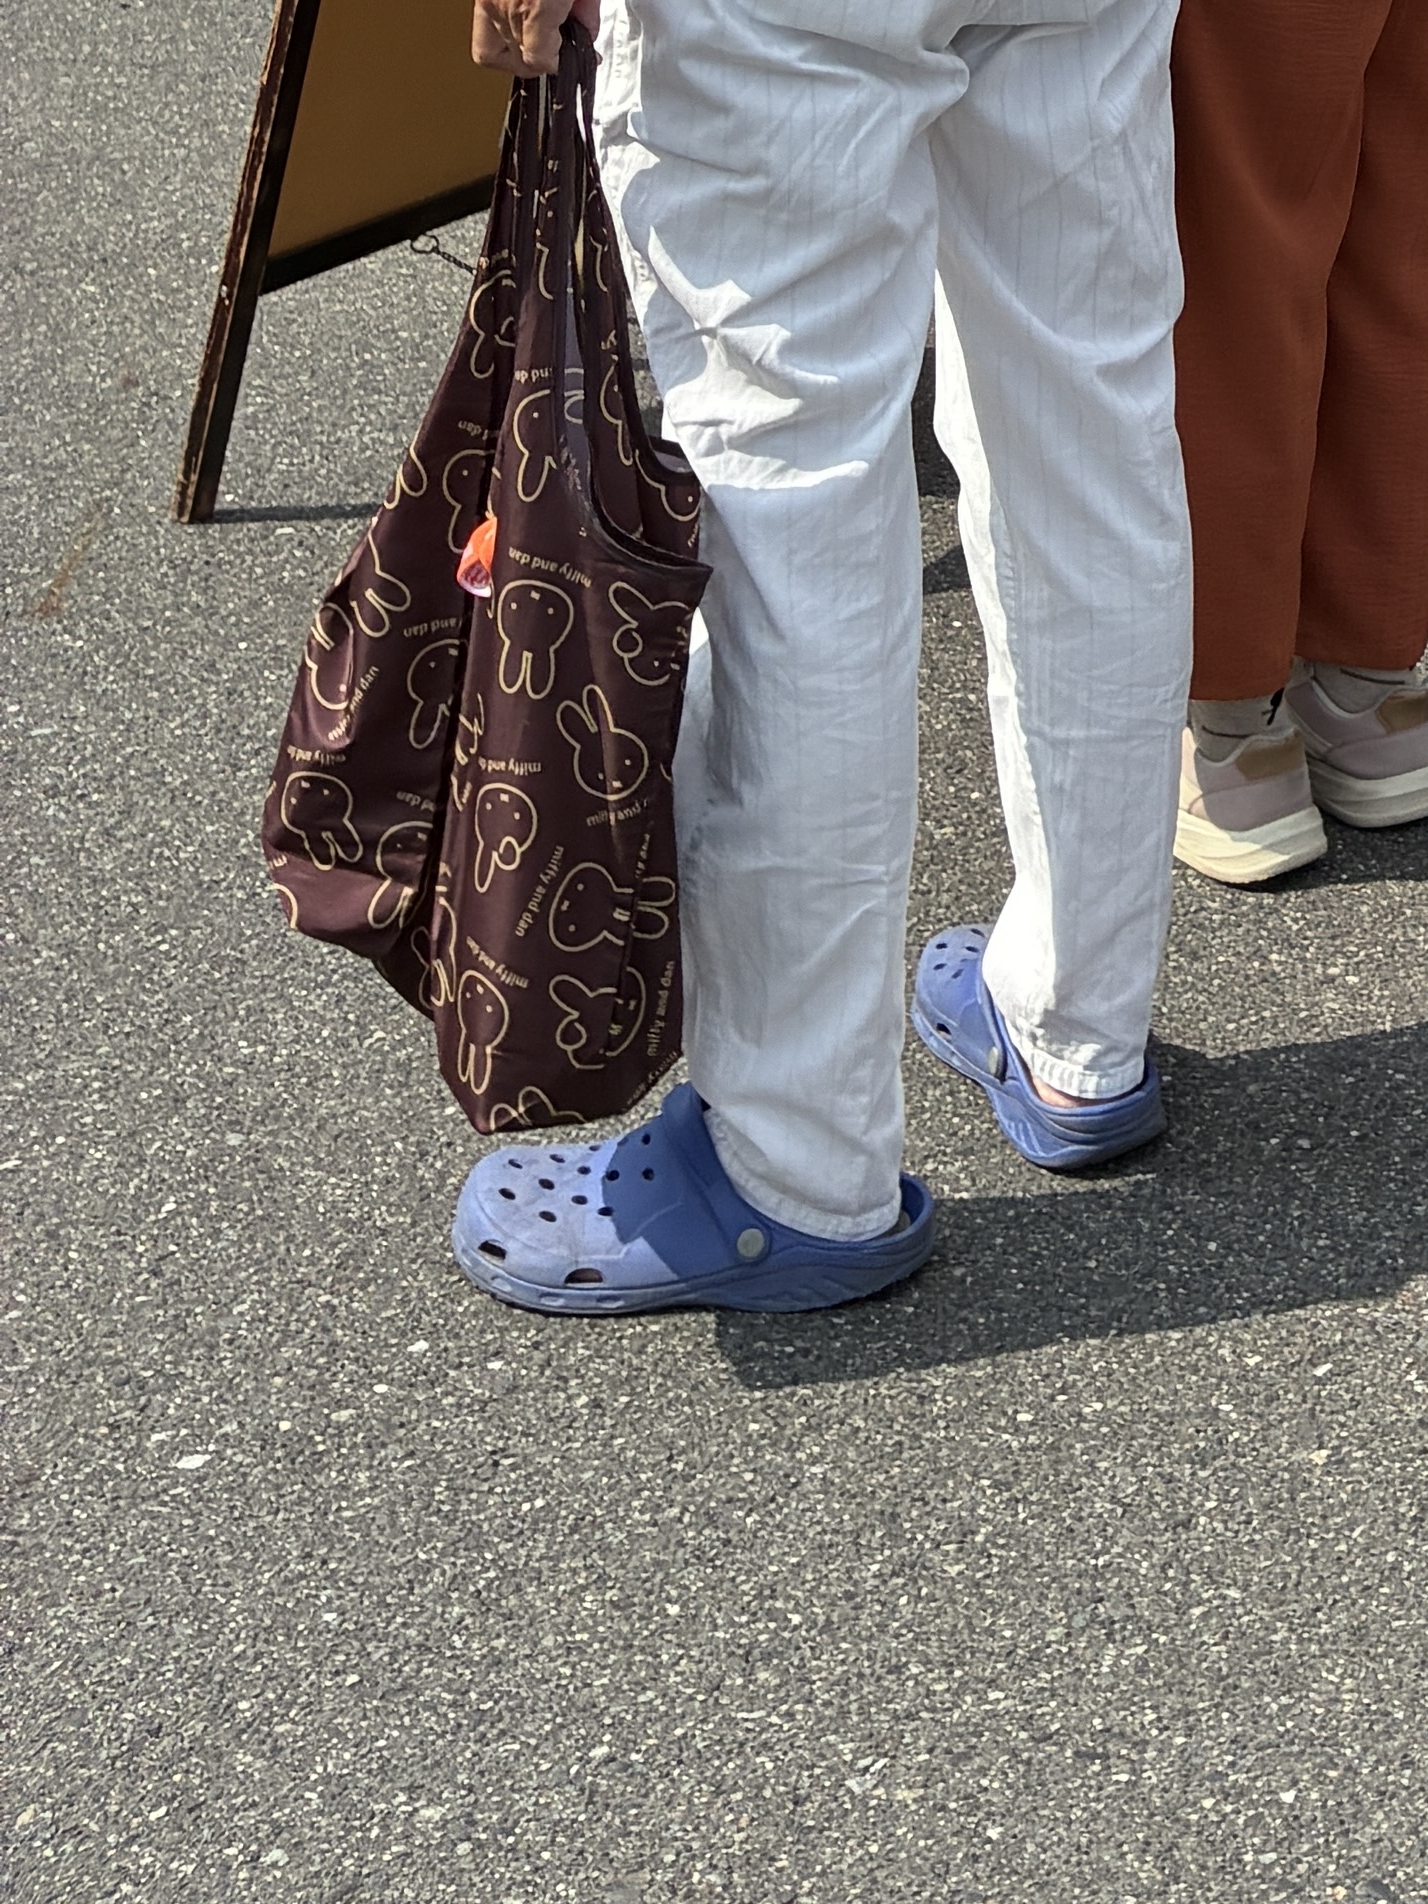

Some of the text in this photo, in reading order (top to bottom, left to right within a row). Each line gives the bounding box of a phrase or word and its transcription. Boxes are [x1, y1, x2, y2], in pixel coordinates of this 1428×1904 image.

[508, 546, 592, 589] miffy and dan
[403, 621, 428, 638] dan
[514, 844, 564, 938] miffy and dan
[661, 960, 676, 988] dan
